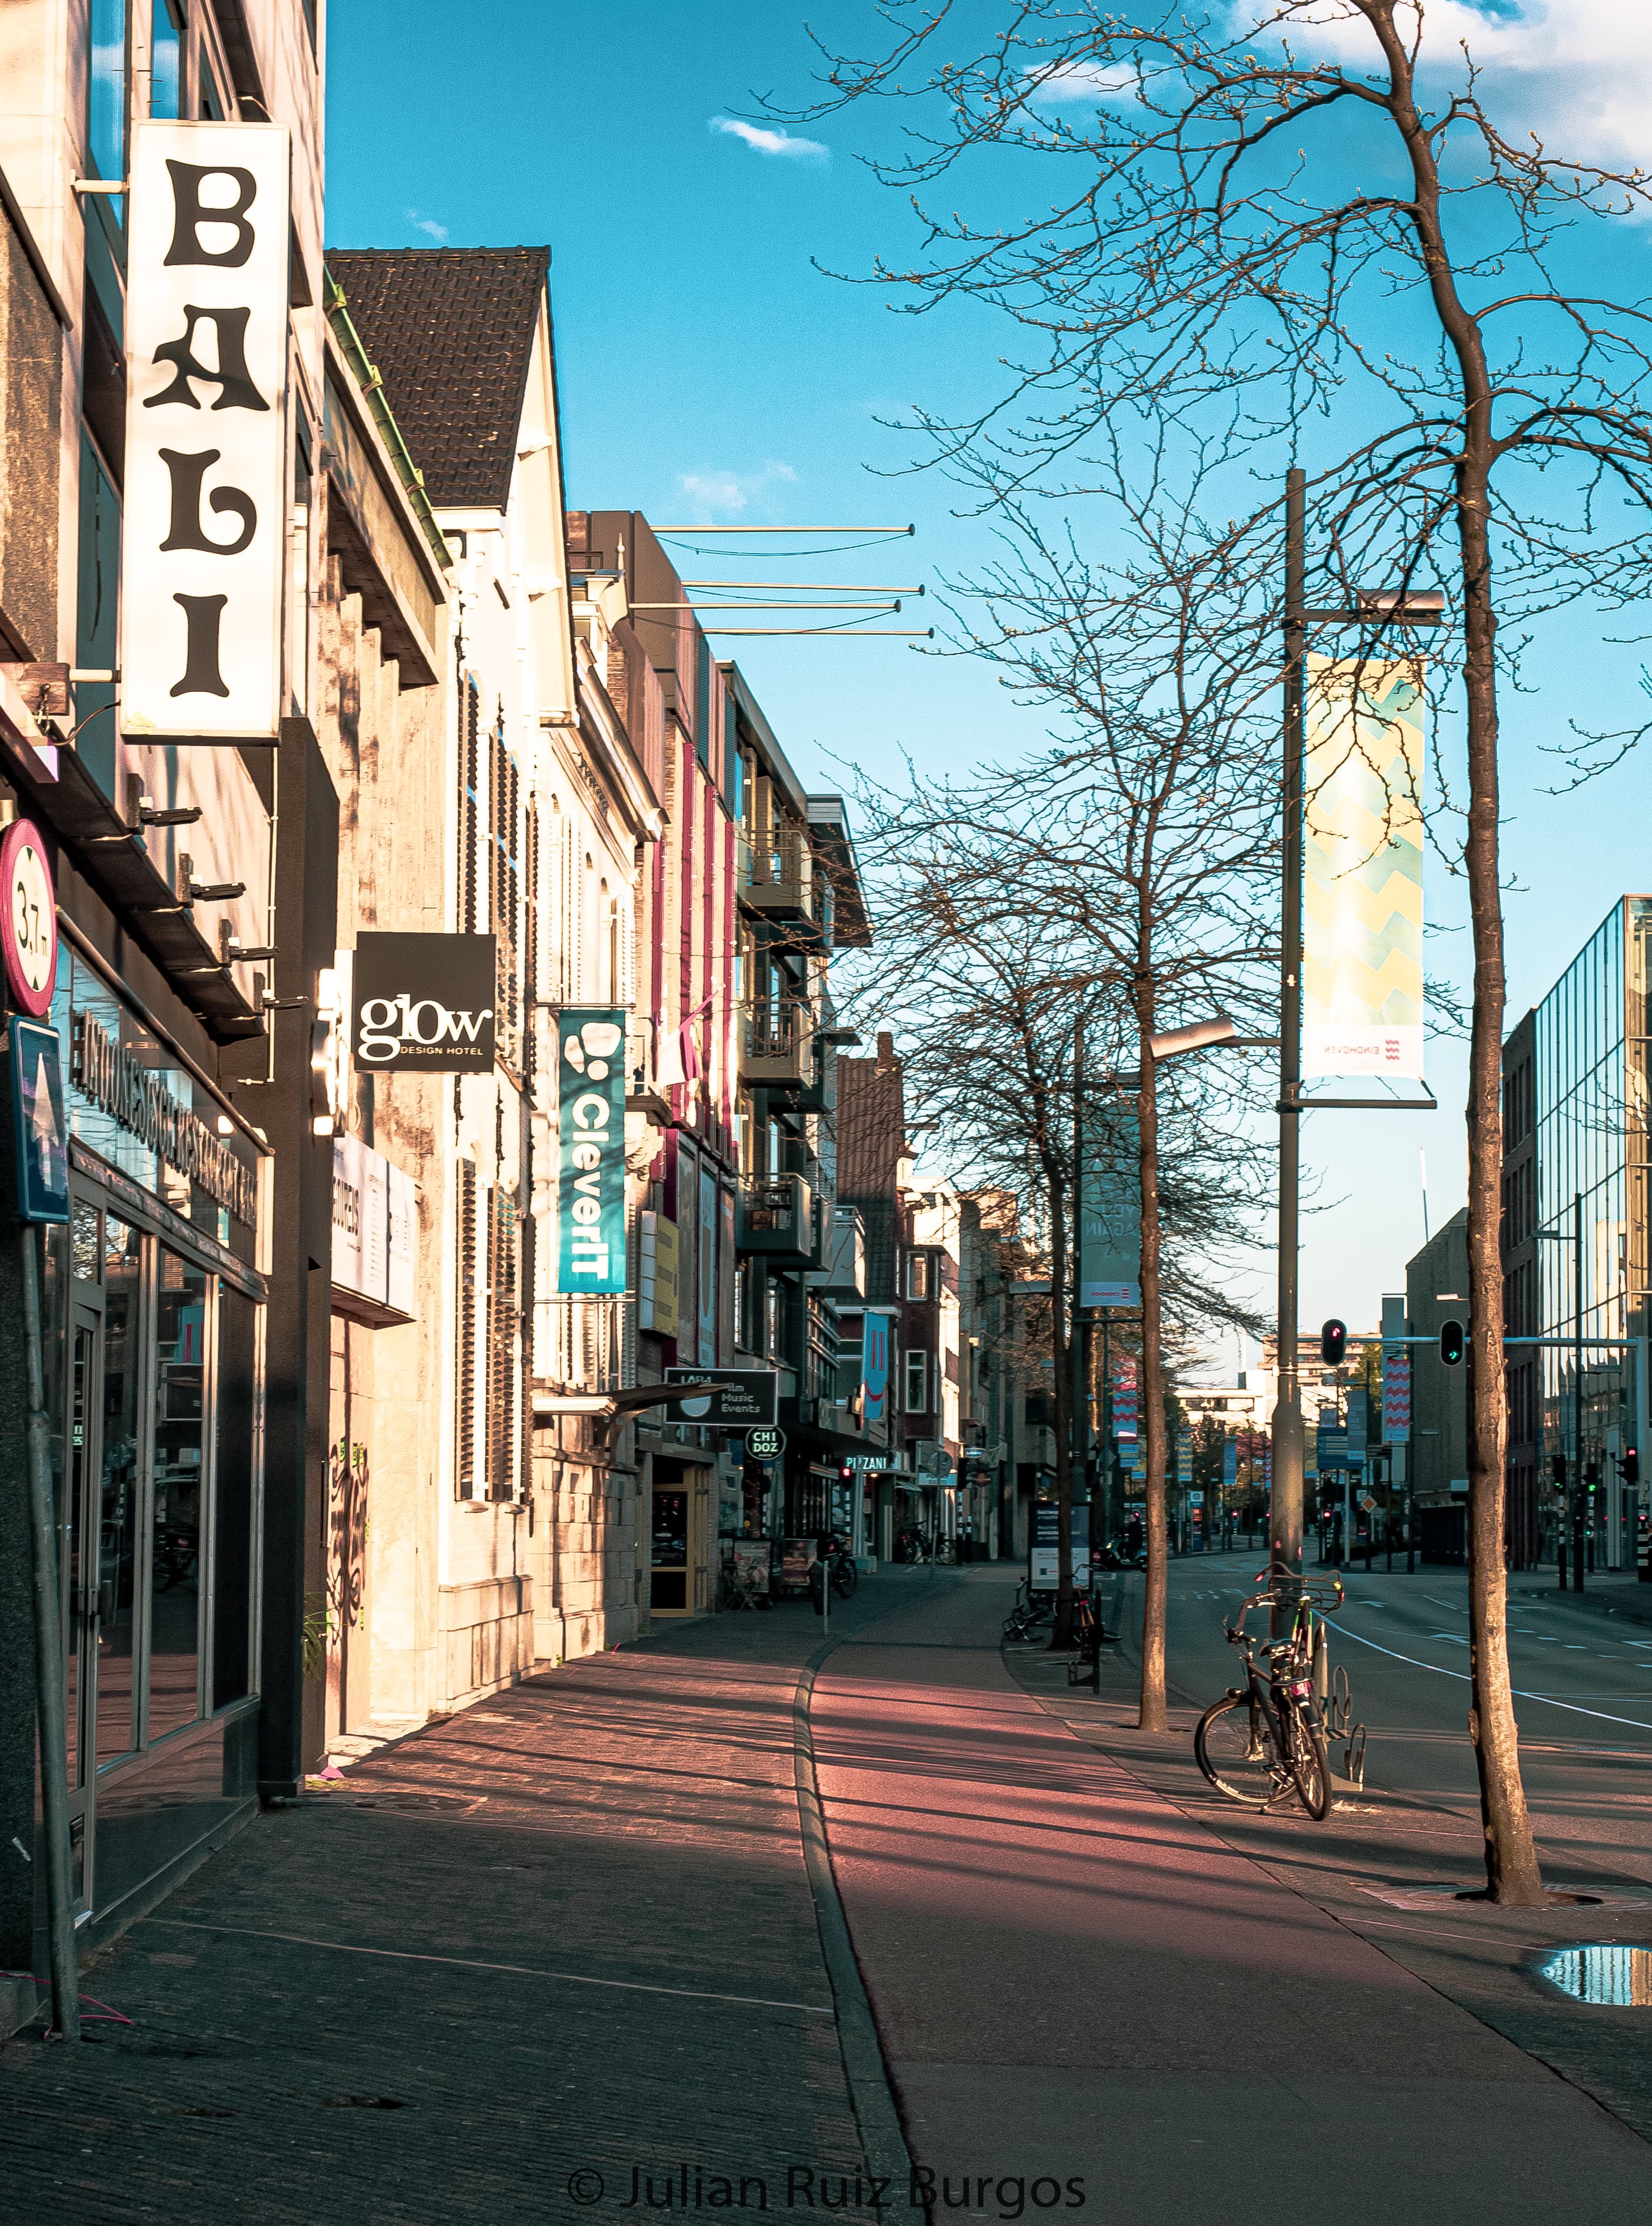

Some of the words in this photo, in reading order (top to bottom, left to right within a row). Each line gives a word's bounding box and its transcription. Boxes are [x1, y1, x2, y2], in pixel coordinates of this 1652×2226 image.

[143, 158, 271, 698] BALI
[358, 994, 494, 1061] glow
[400, 1046, 443, 1054] DESIGN
[446, 1047, 484, 1055] HOTEL
[571, 1093, 611, 1280] CleverIT
[721, 1393, 754, 1402] Music
[721, 1403, 761, 1413] Events
[753, 1432, 776, 1442] CHI
[753, 1443, 779, 1452] DOZ
